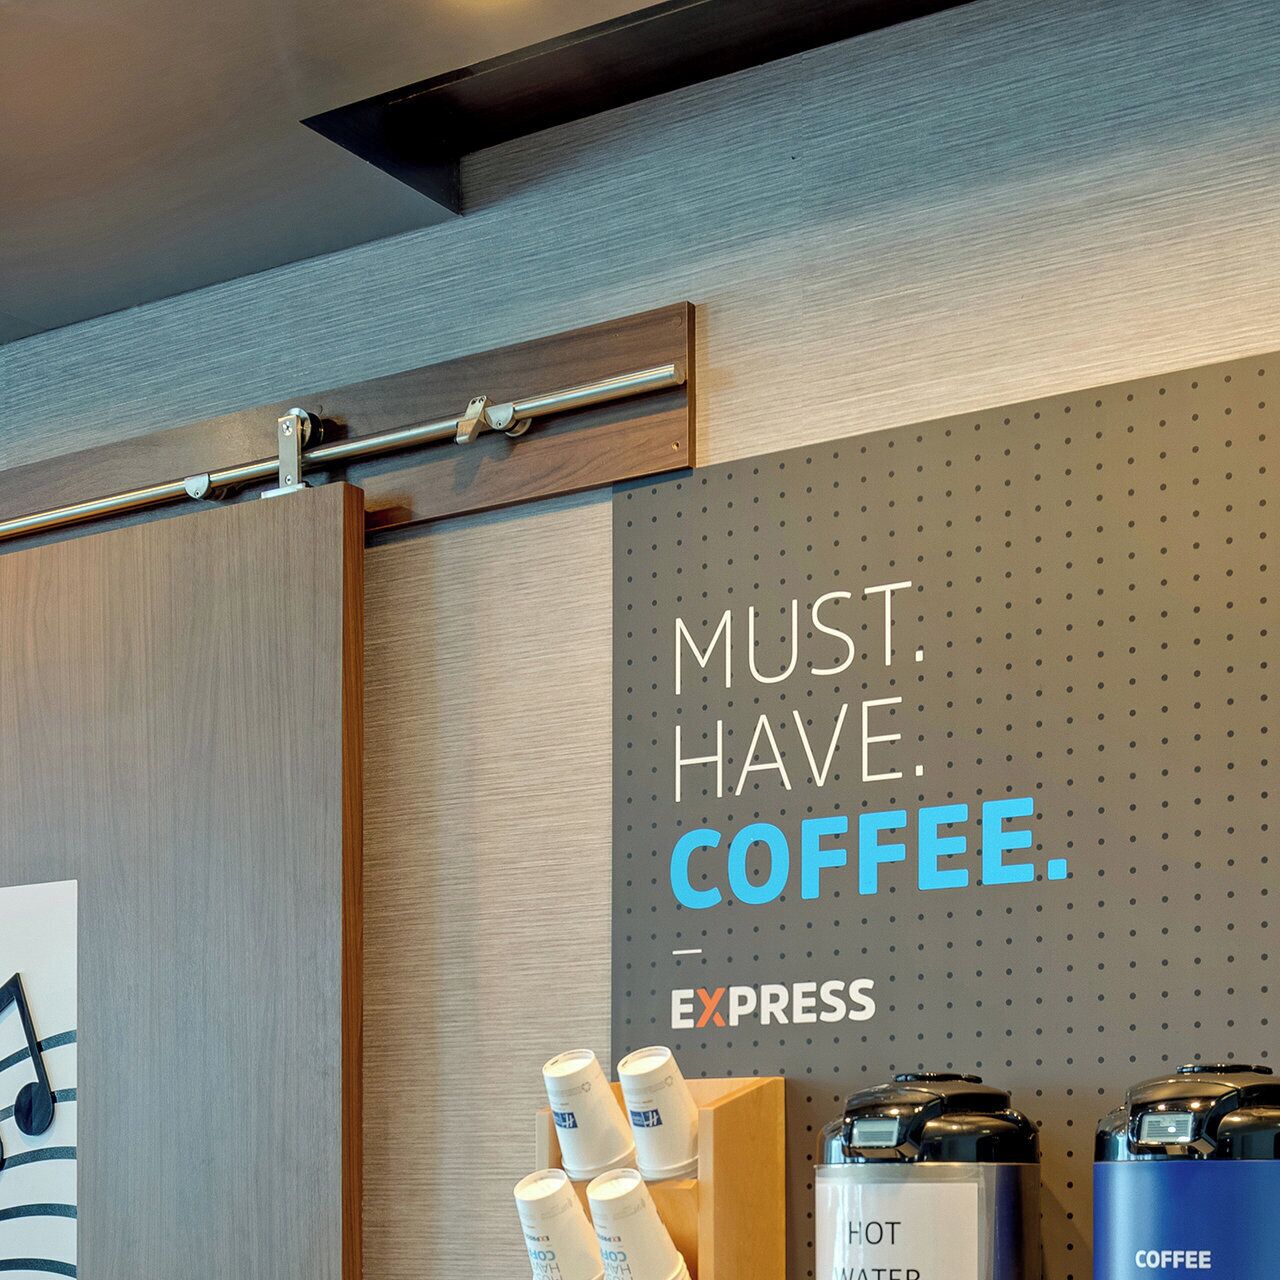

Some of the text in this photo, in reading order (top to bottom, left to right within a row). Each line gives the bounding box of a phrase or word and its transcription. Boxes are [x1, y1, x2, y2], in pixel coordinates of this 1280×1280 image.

[675, 581, 924, 695] MUST.
[675, 696, 924, 802] HAVE.
[670, 797, 1068, 909] COFFEE.
[670, 978, 876, 1029] EXPRESS
[848, 1221, 901, 1245] HOT
[1135, 1249, 1212, 1269] COFFEE
